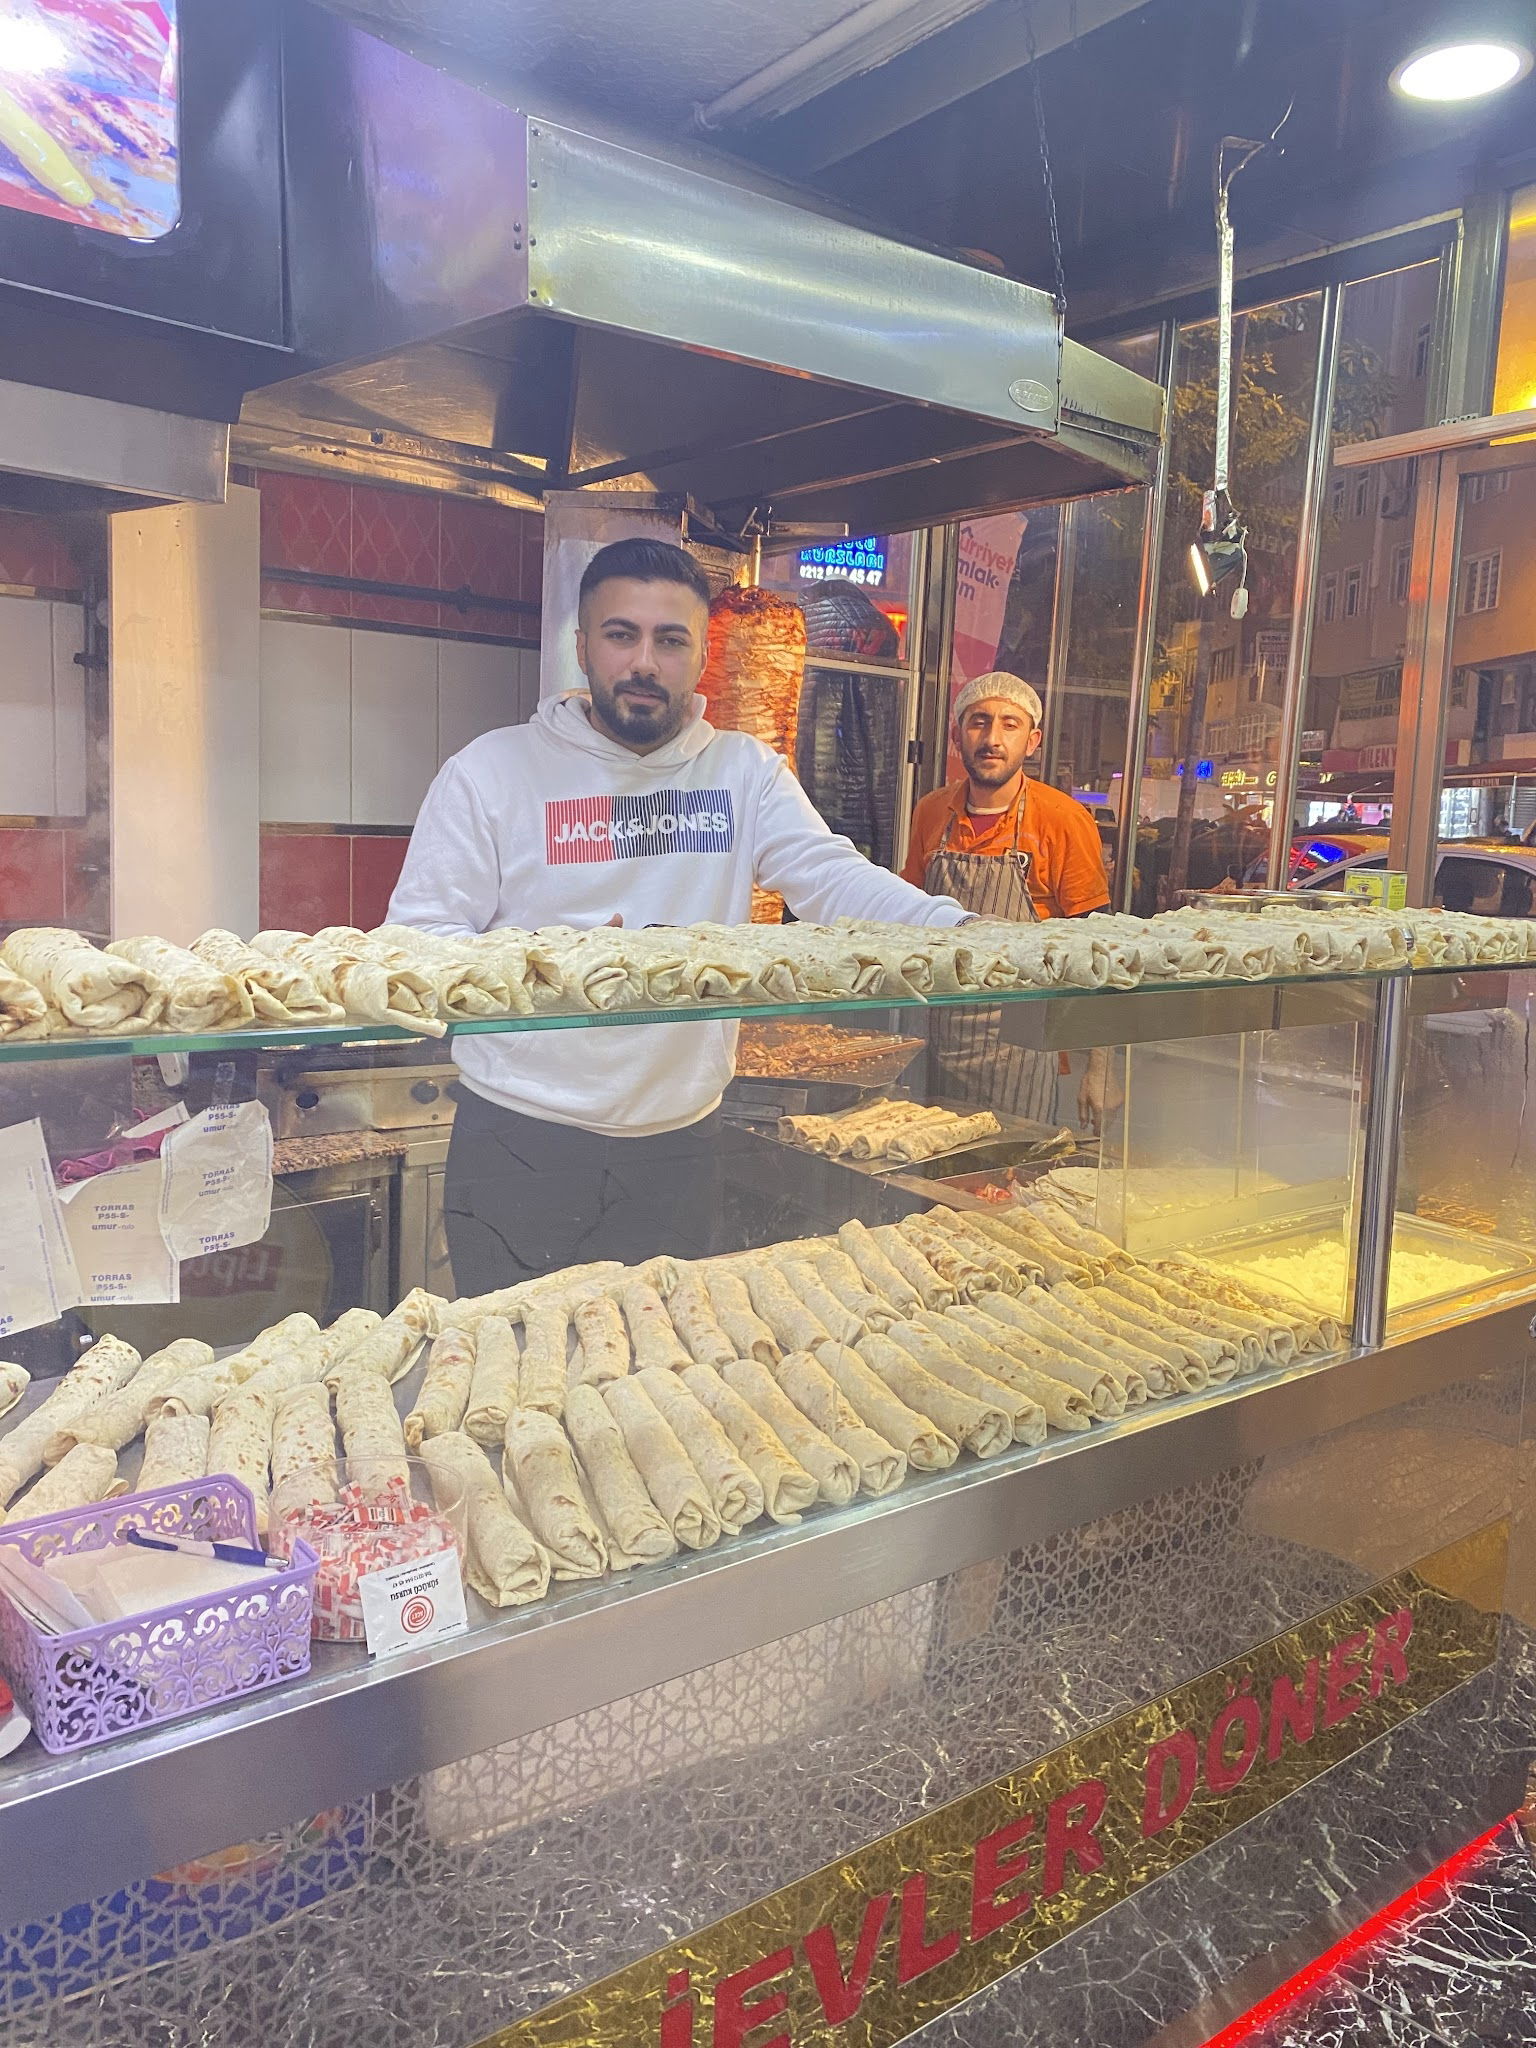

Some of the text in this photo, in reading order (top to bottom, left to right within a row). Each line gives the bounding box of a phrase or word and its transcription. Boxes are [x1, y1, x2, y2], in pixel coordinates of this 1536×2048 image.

[553, 811, 728, 844] JACK&JONES
[94, 1204, 135, 1212] TORRAS
[198, 1231, 236, 1245] TORRAS
[91, 1273, 132, 1282] TORRAS
[389, 1587, 413, 1601] KURSU
[1142, 1606, 1413, 1839] DÖNER
